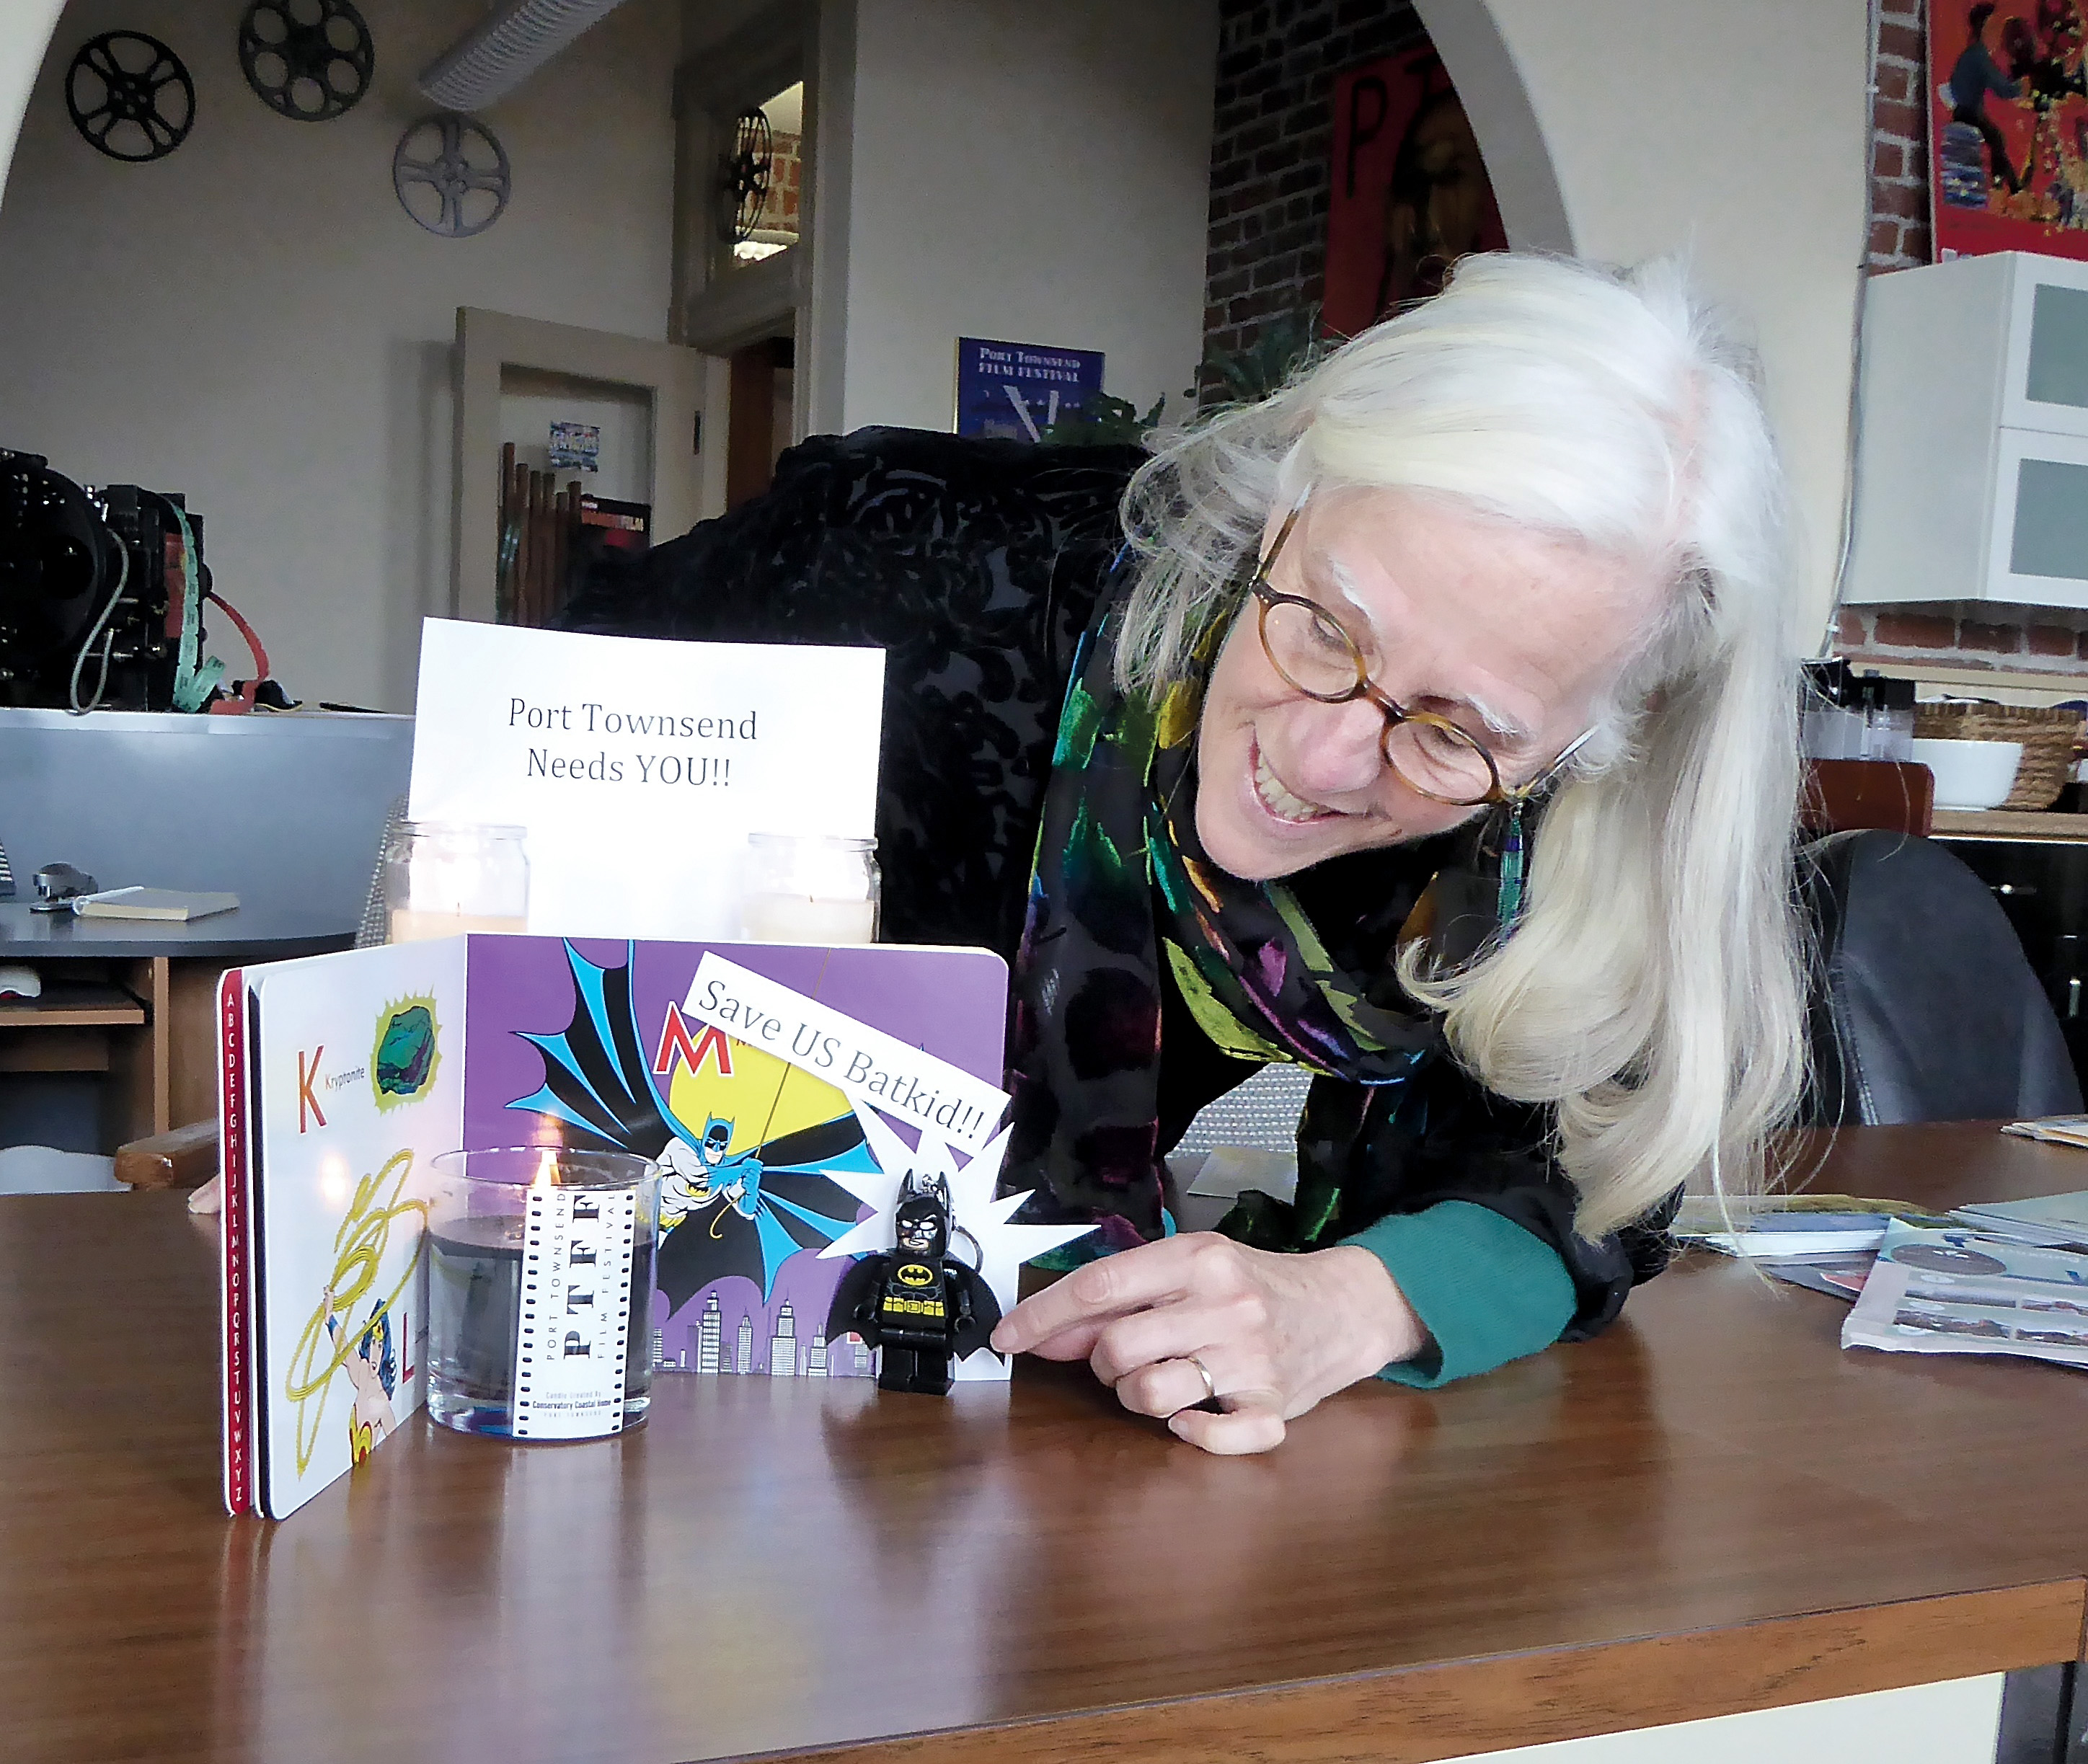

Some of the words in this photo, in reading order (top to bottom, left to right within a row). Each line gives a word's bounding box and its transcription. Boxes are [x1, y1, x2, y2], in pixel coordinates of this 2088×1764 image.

[978, 362, 1013, 376] FILM
[1017, 366, 1079, 382] FESTIVAL
[979, 347, 1012, 363] PORT
[1015, 350, 1081, 369] TOWNSEND
[509, 697, 572, 730] Port
[582, 703, 757, 740] Townsend
[527, 748, 624, 782] Needs
[636, 755, 730, 786] YOU!!
[324, 1065, 365, 1092] Kryptonite
[699, 980, 782, 1041] Save
[792, 1022, 843, 1068] US
[844, 1050, 985, 1140] Batkid!!
[298, 1044, 327, 1135] K
[550, 1193, 566, 1299] TOWNSEND
[602, 1195, 615, 1293] FESTIVAL
[547, 1315, 558, 1360] PORT
[597, 1312, 608, 1359] FILM
[532, 1401, 573, 1410] Conservatory
[575, 1400, 596, 1409] Coastal
